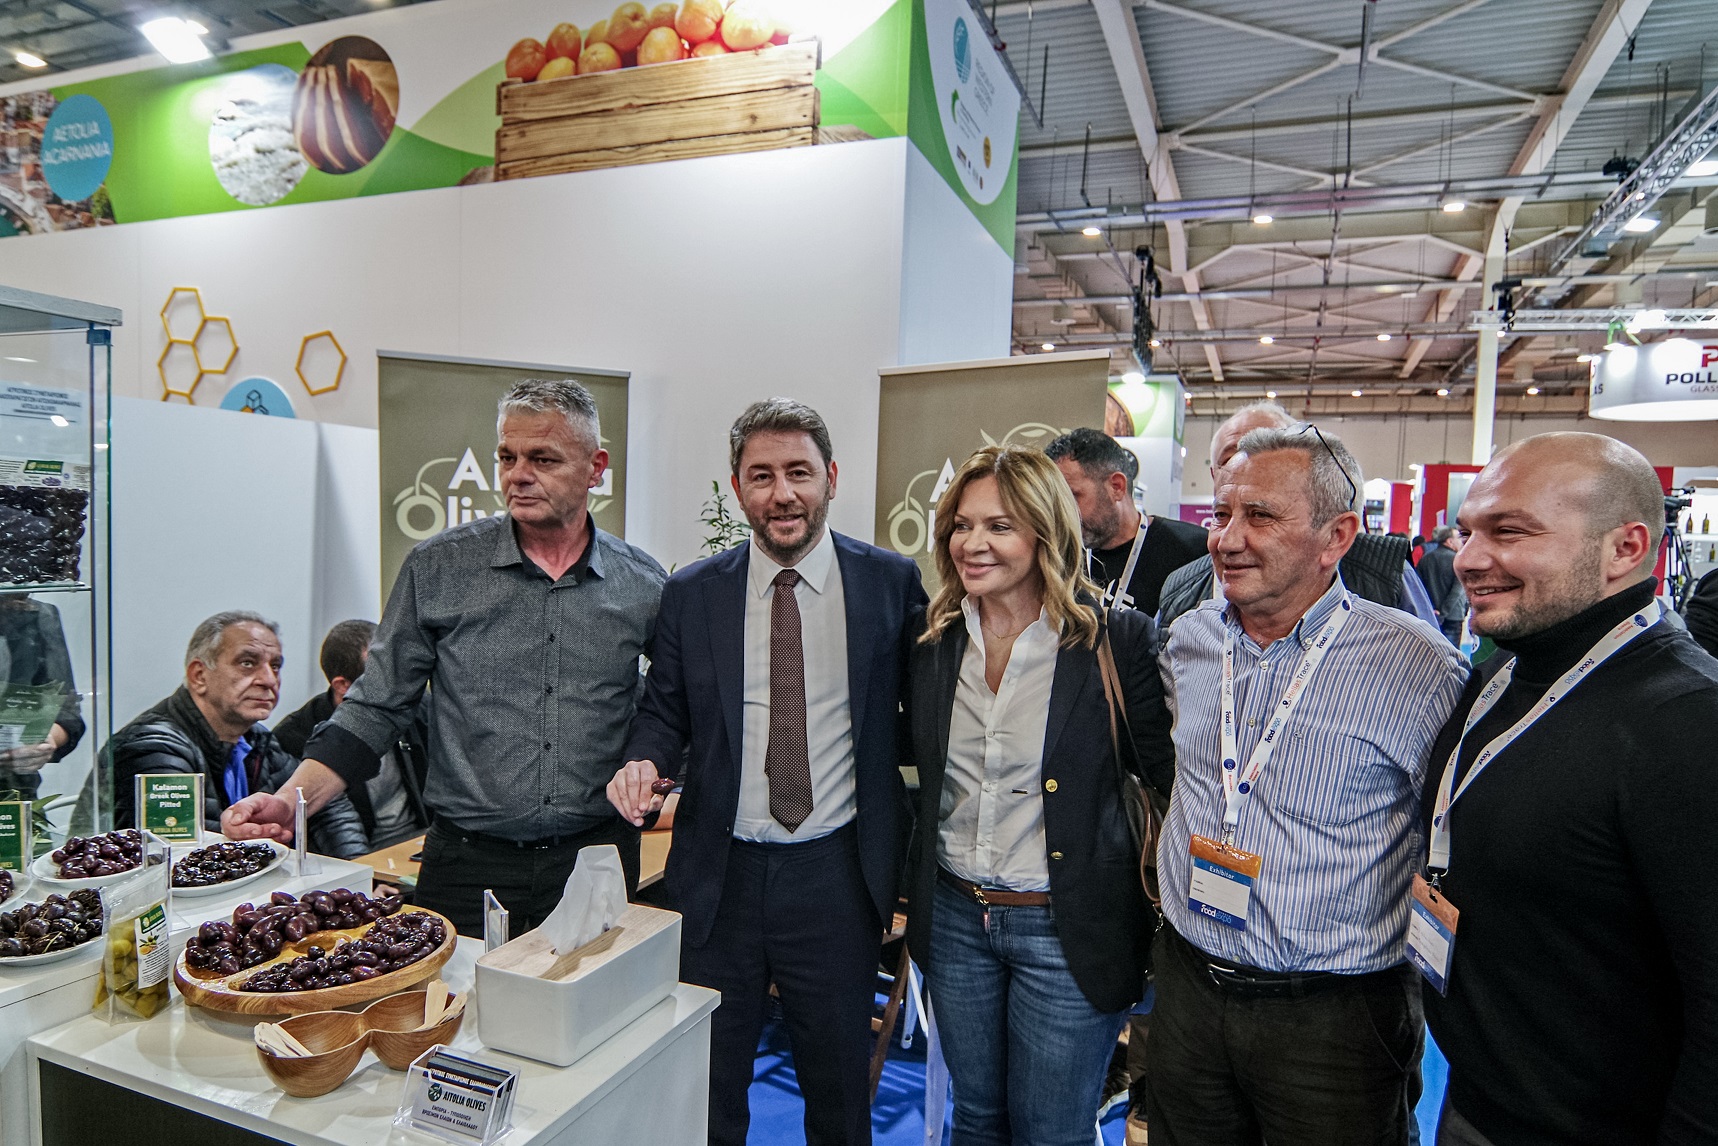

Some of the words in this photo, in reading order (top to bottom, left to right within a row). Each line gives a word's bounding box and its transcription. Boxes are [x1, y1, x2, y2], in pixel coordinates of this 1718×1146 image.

[53, 121, 101, 143] AETOLIA
[43, 141, 111, 165] ACARNANIA
[1209, 865, 1235, 880] Exhibitor
[443, 1091, 464, 1105] AITOLIA
[465, 1097, 486, 1111] OLIVES
